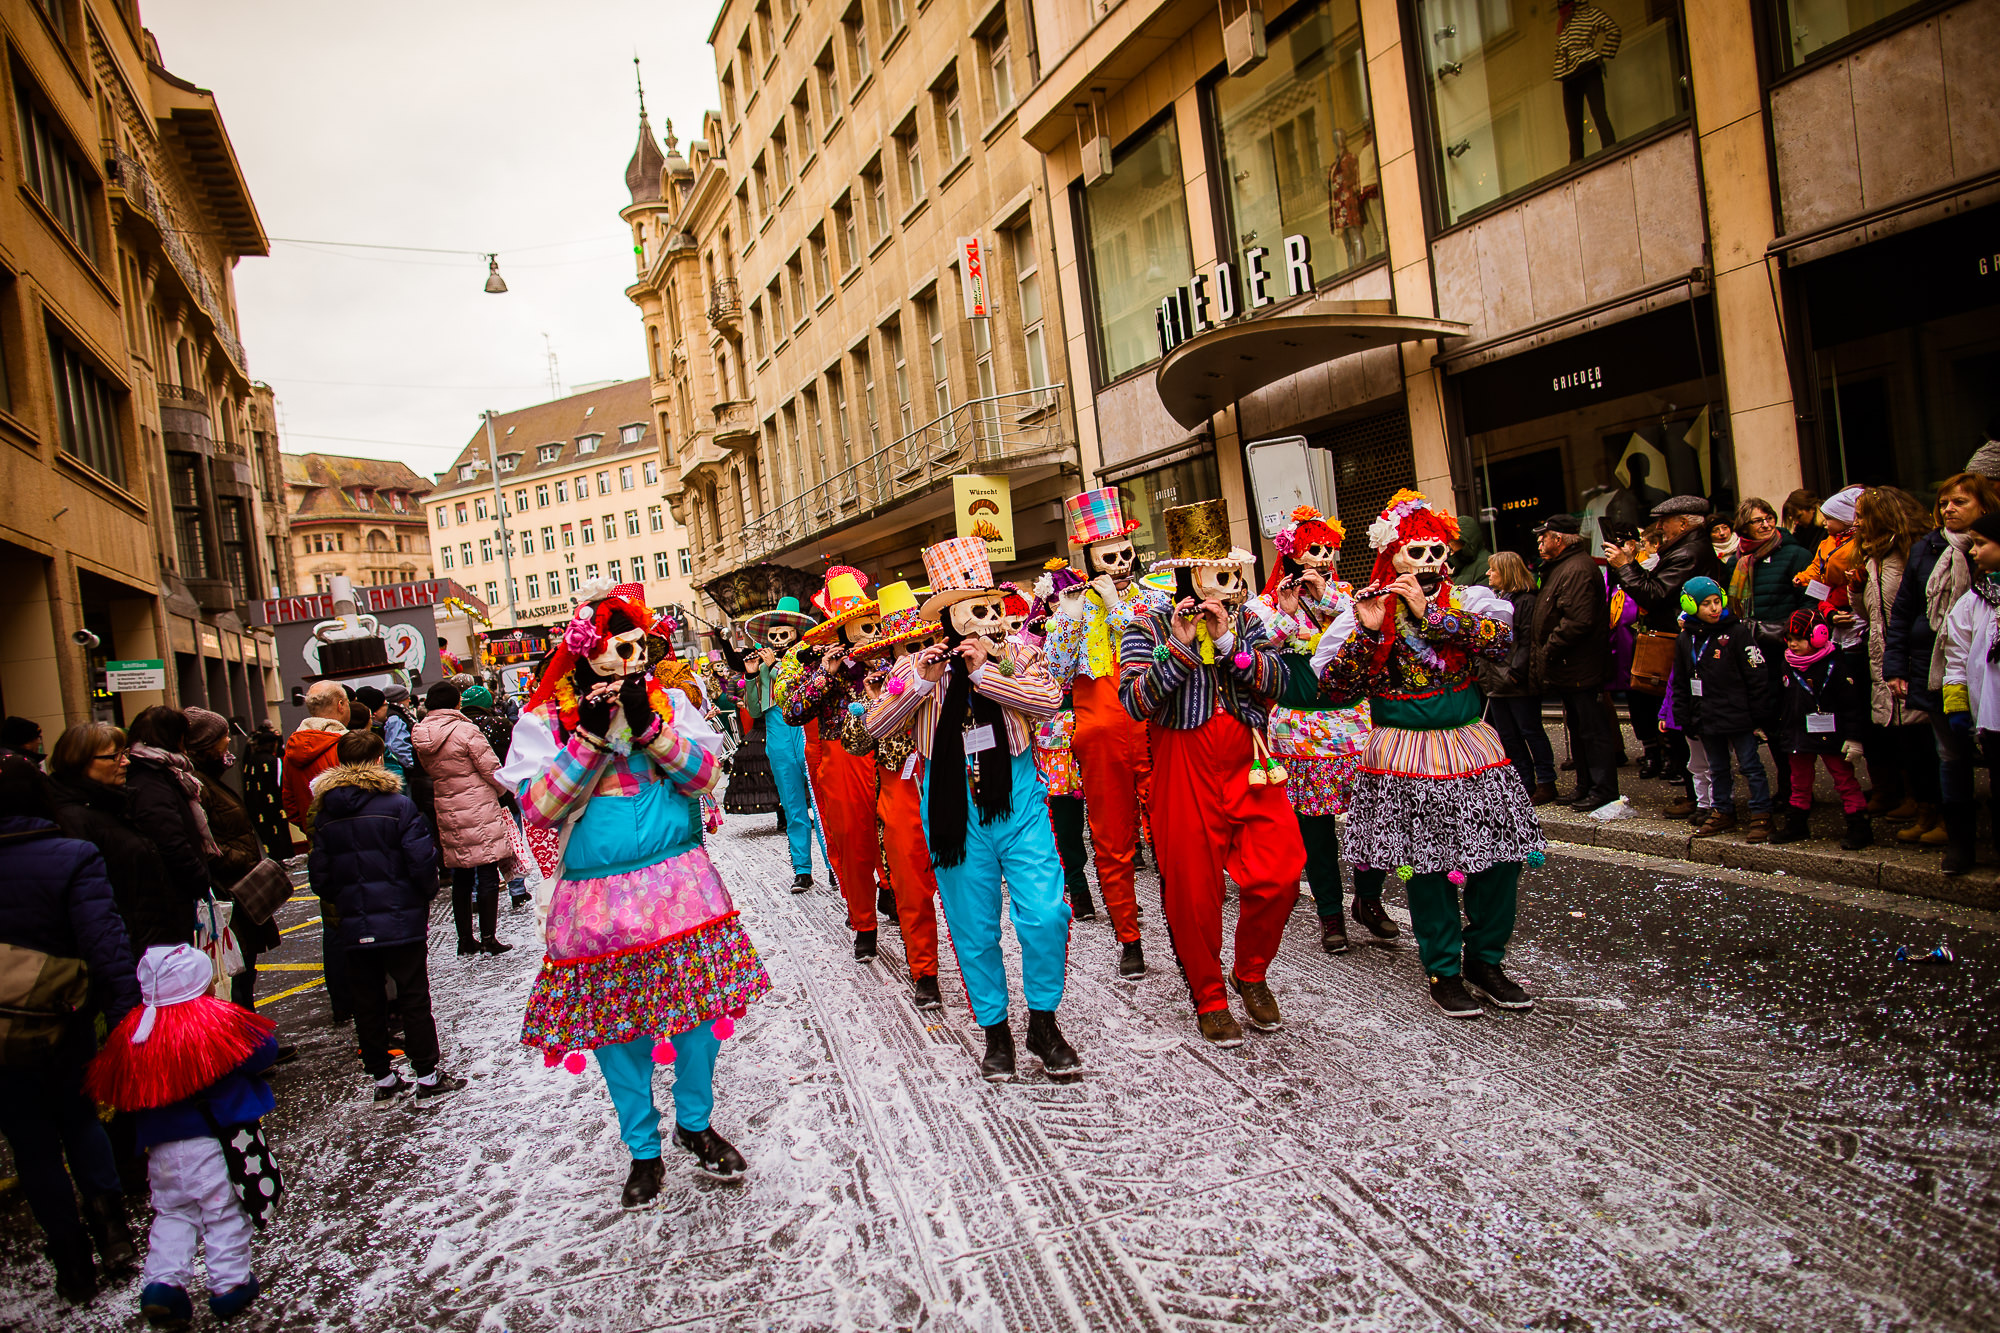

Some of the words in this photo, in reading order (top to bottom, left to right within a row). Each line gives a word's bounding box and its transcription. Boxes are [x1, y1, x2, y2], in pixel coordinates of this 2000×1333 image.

[966, 238, 982, 279] XXL
[1553, 366, 1601, 391] GRIEDER
[968, 488, 998, 496] Würscht
[1155, 486, 1177, 501] GRIEDER
[986, 546, 1012, 555] hlegrill
[263, 595, 335, 624] FANTA
[367, 588, 396, 612] AM
[399, 582, 439, 608] RHY
[516, 603, 568, 620] BRASSERIE
[490, 641, 520, 656] MORTA
[521, 638, 547, 653] BELLA
